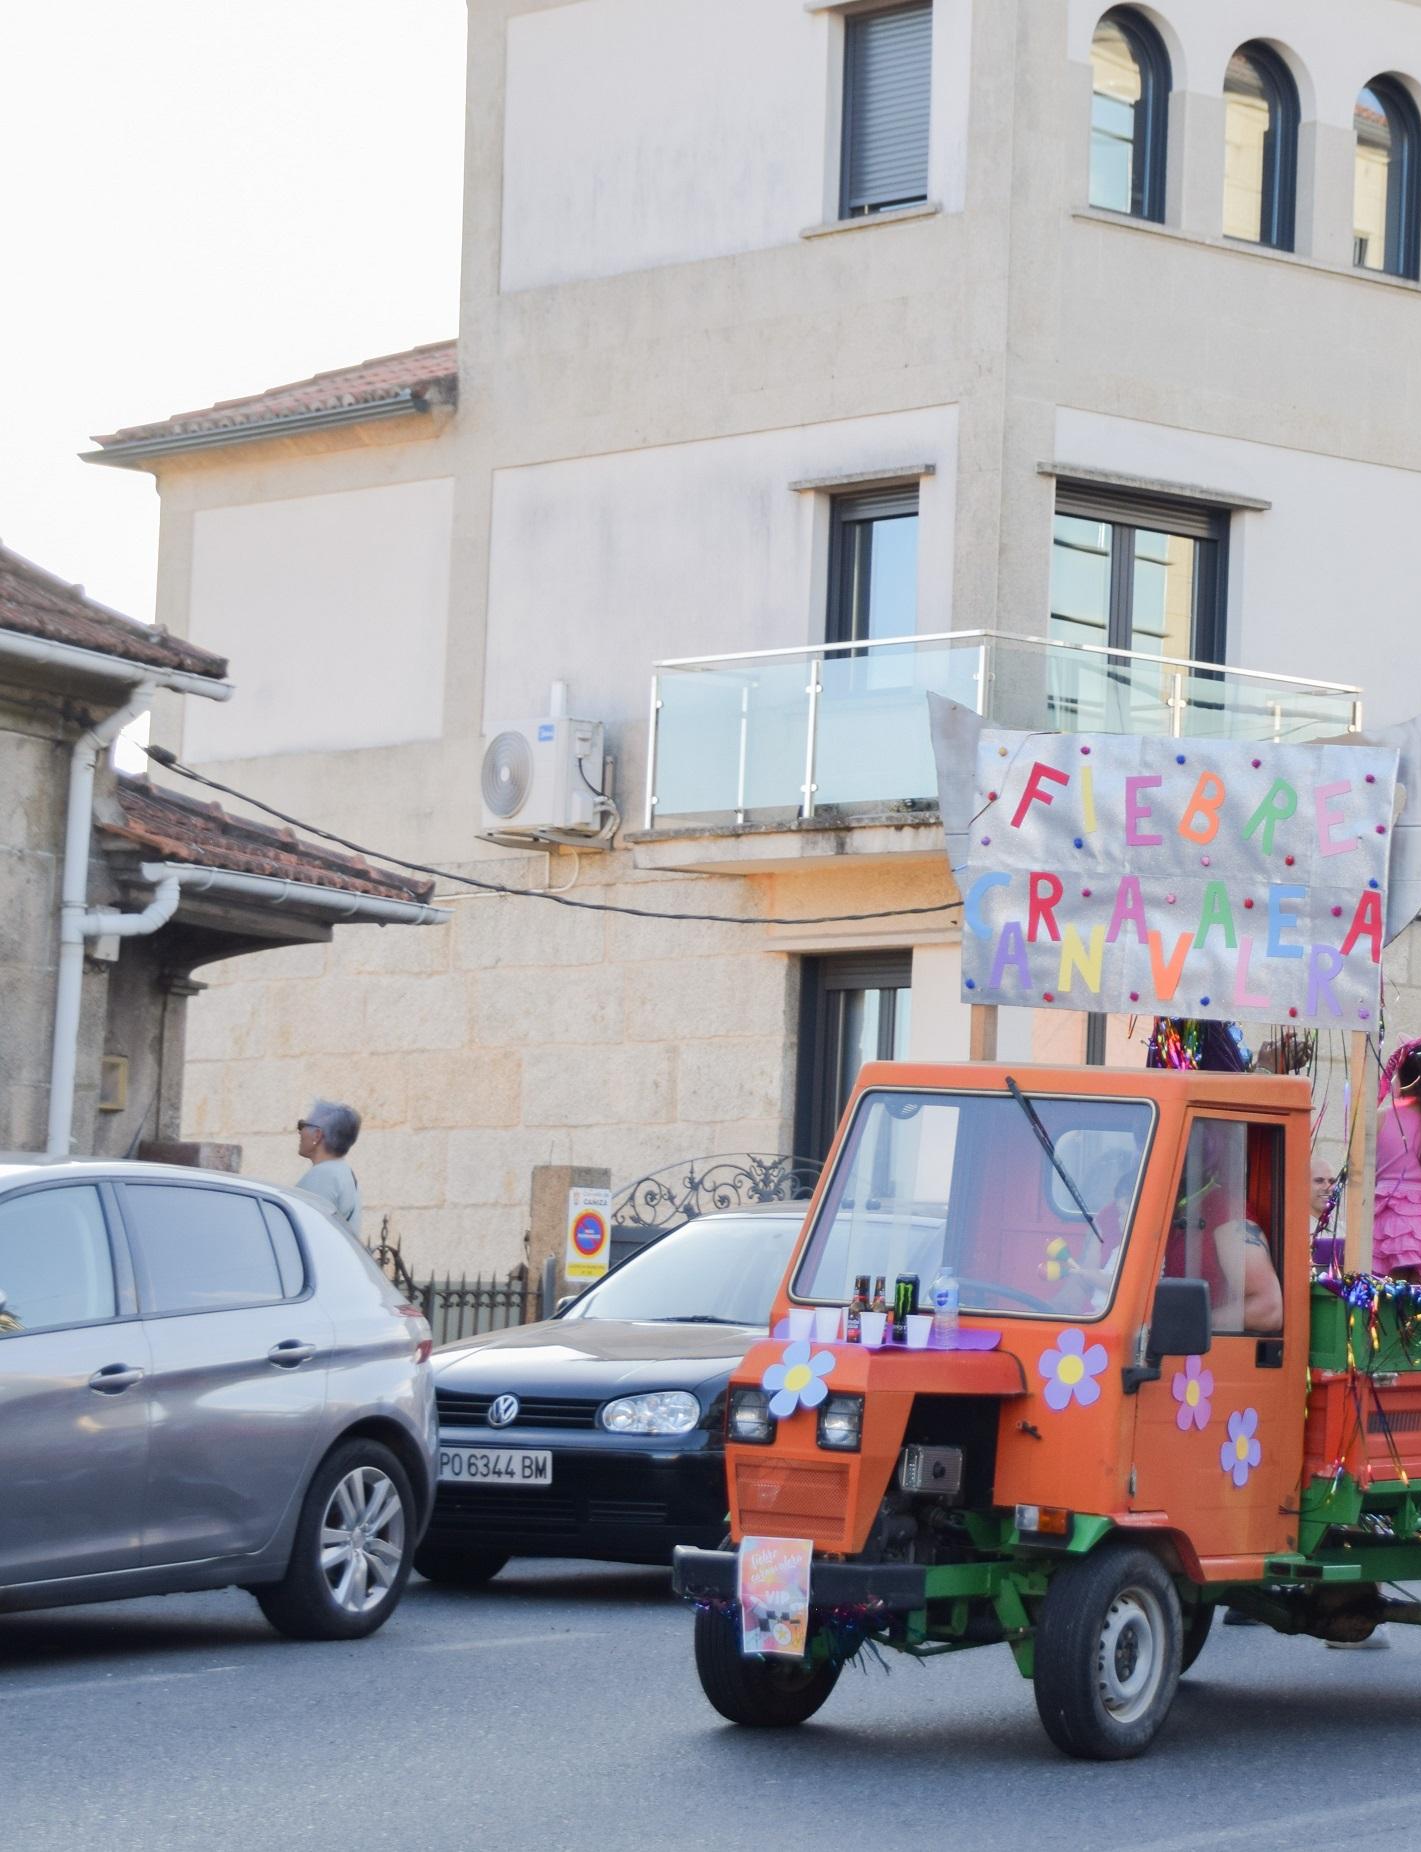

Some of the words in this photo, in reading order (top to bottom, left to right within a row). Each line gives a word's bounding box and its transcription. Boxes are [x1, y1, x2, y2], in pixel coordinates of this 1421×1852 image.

[1010, 761, 1358, 857] FIEBRE
[440, 1452, 463, 1476] PO
[467, 1454, 516, 1478] 6344
[521, 1456, 547, 1479] BM
